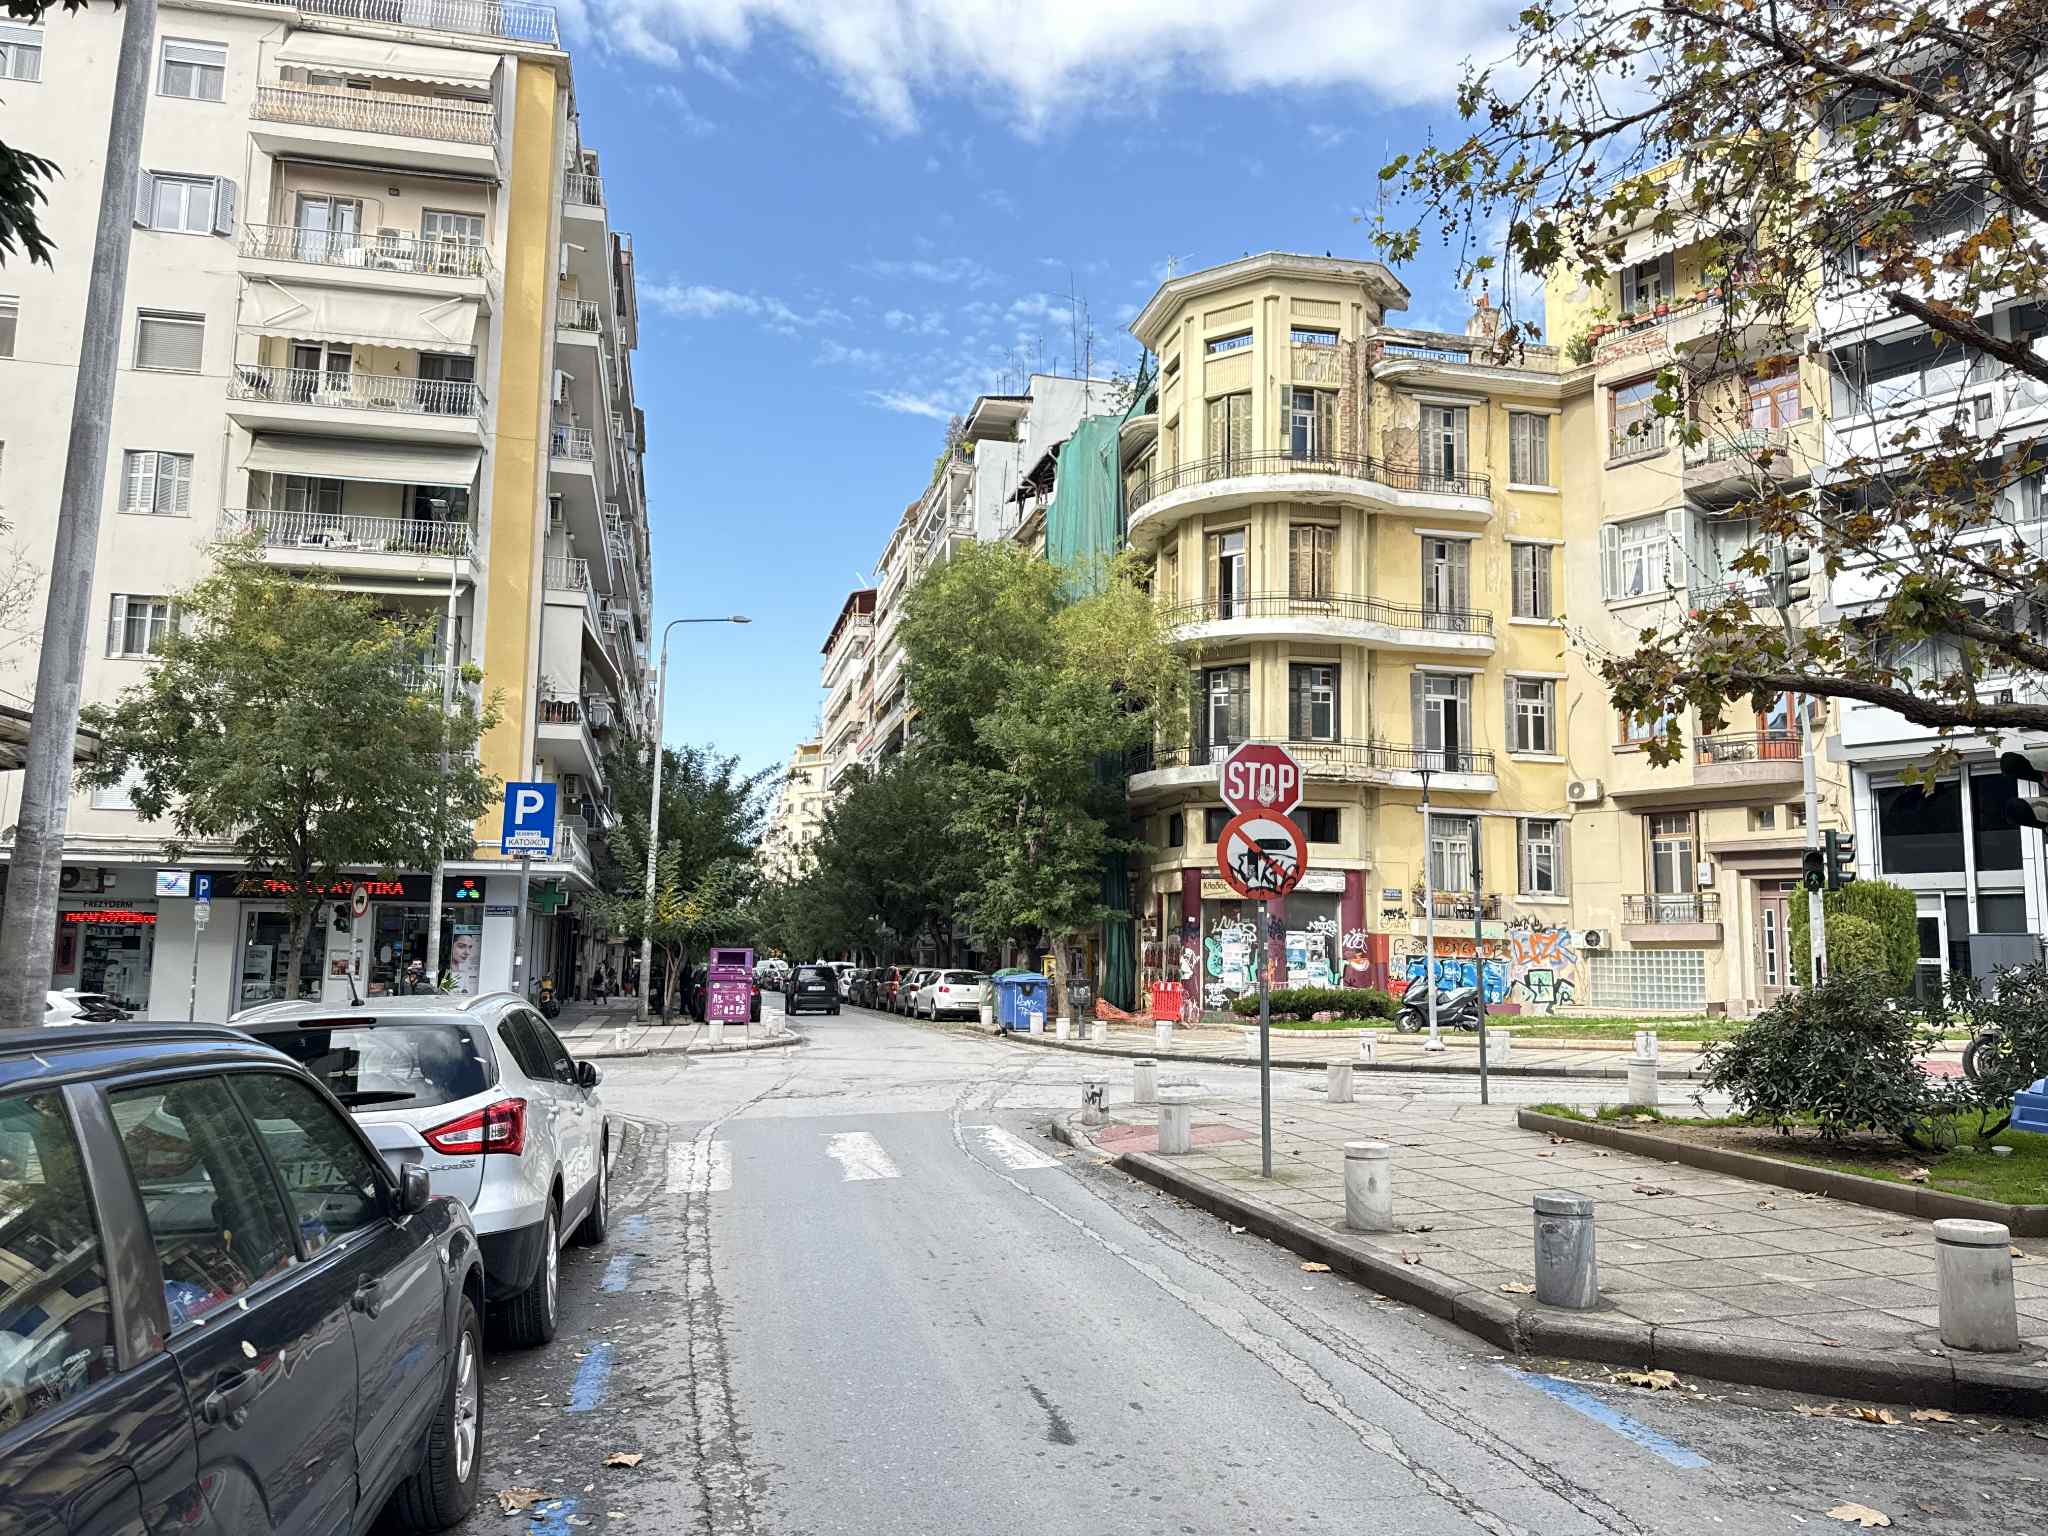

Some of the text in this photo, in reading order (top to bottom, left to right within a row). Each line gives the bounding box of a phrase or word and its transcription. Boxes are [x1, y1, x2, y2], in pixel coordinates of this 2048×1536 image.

[1228, 761, 1295, 803] STOP
[514, 789, 545, 825] P
[199, 878, 209, 896] P
